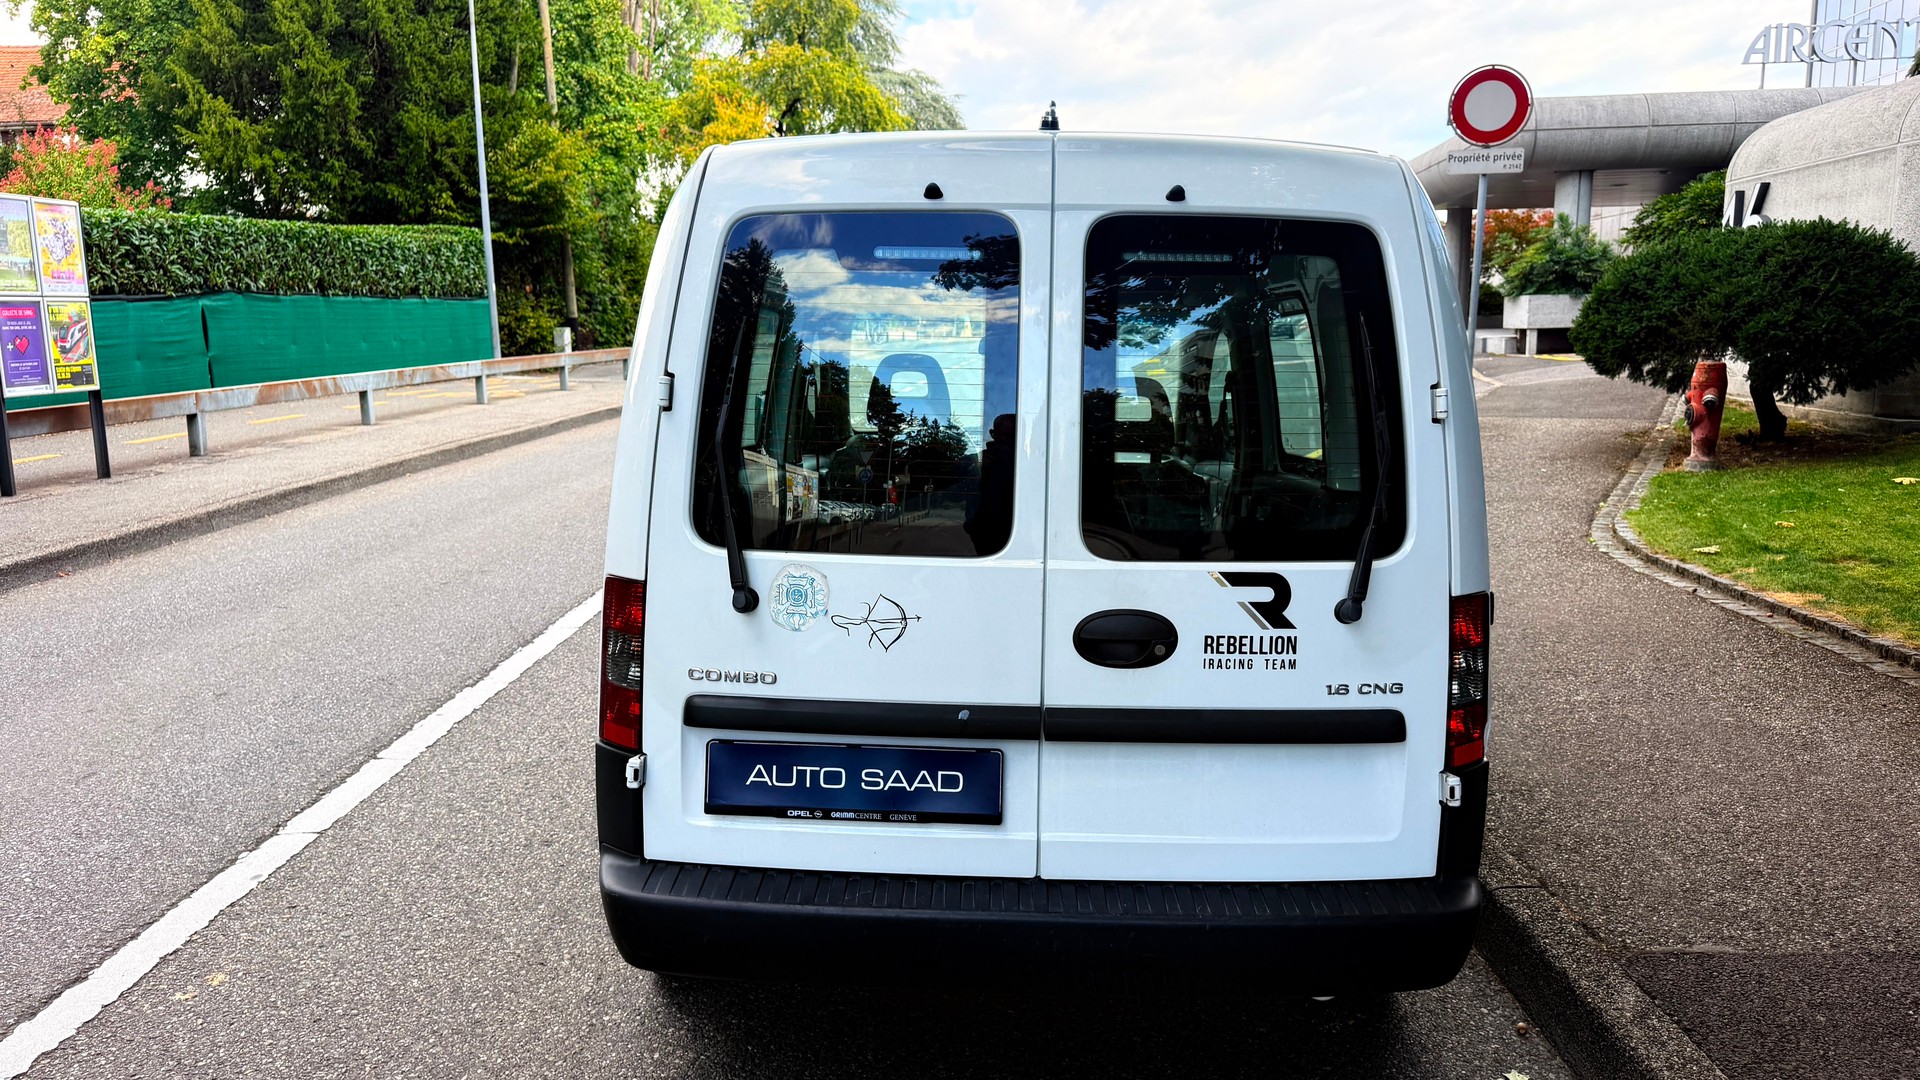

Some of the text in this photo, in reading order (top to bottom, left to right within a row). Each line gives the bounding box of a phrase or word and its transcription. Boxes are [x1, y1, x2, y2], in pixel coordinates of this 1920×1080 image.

[1448, 152, 1523, 164] Propriété privée
[1204, 635, 1298, 655] REBELLION
[1203, 658, 1297, 670] IRACING TEAM
[688, 667, 777, 685] COMBO
[1357, 682, 1404, 695] CNG
[746, 764, 964, 793] AUTO SAAD
